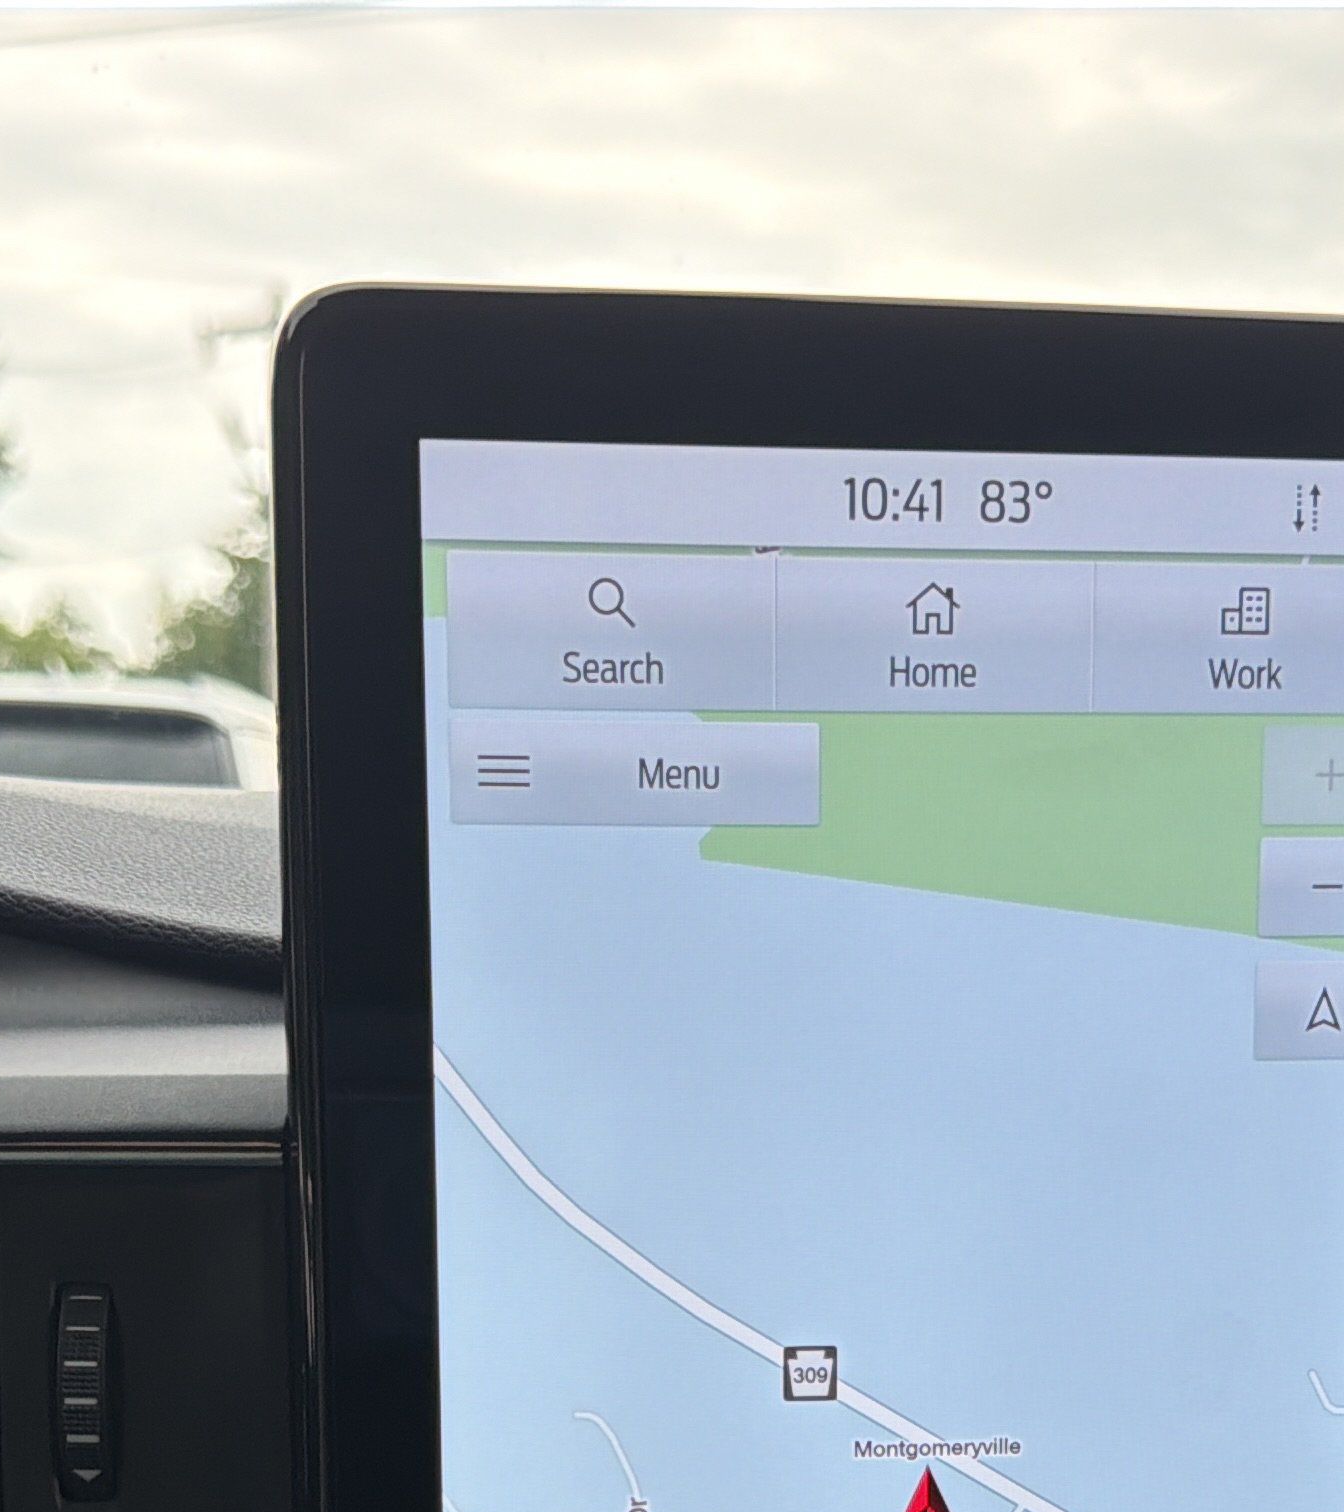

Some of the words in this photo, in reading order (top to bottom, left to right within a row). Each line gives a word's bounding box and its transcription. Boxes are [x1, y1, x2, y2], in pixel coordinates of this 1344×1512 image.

[843, 477, 943, 523] 10:41
[980, 479, 1054, 524] 83°
[562, 651, 665, 685] Search
[888, 656, 977, 688] Home
[1208, 657, 1283, 690] Work
[638, 757, 720, 790] Menu
[792, 1366, 829, 1385] 309
[854, 1437, 1022, 1461] Montgomeryville
